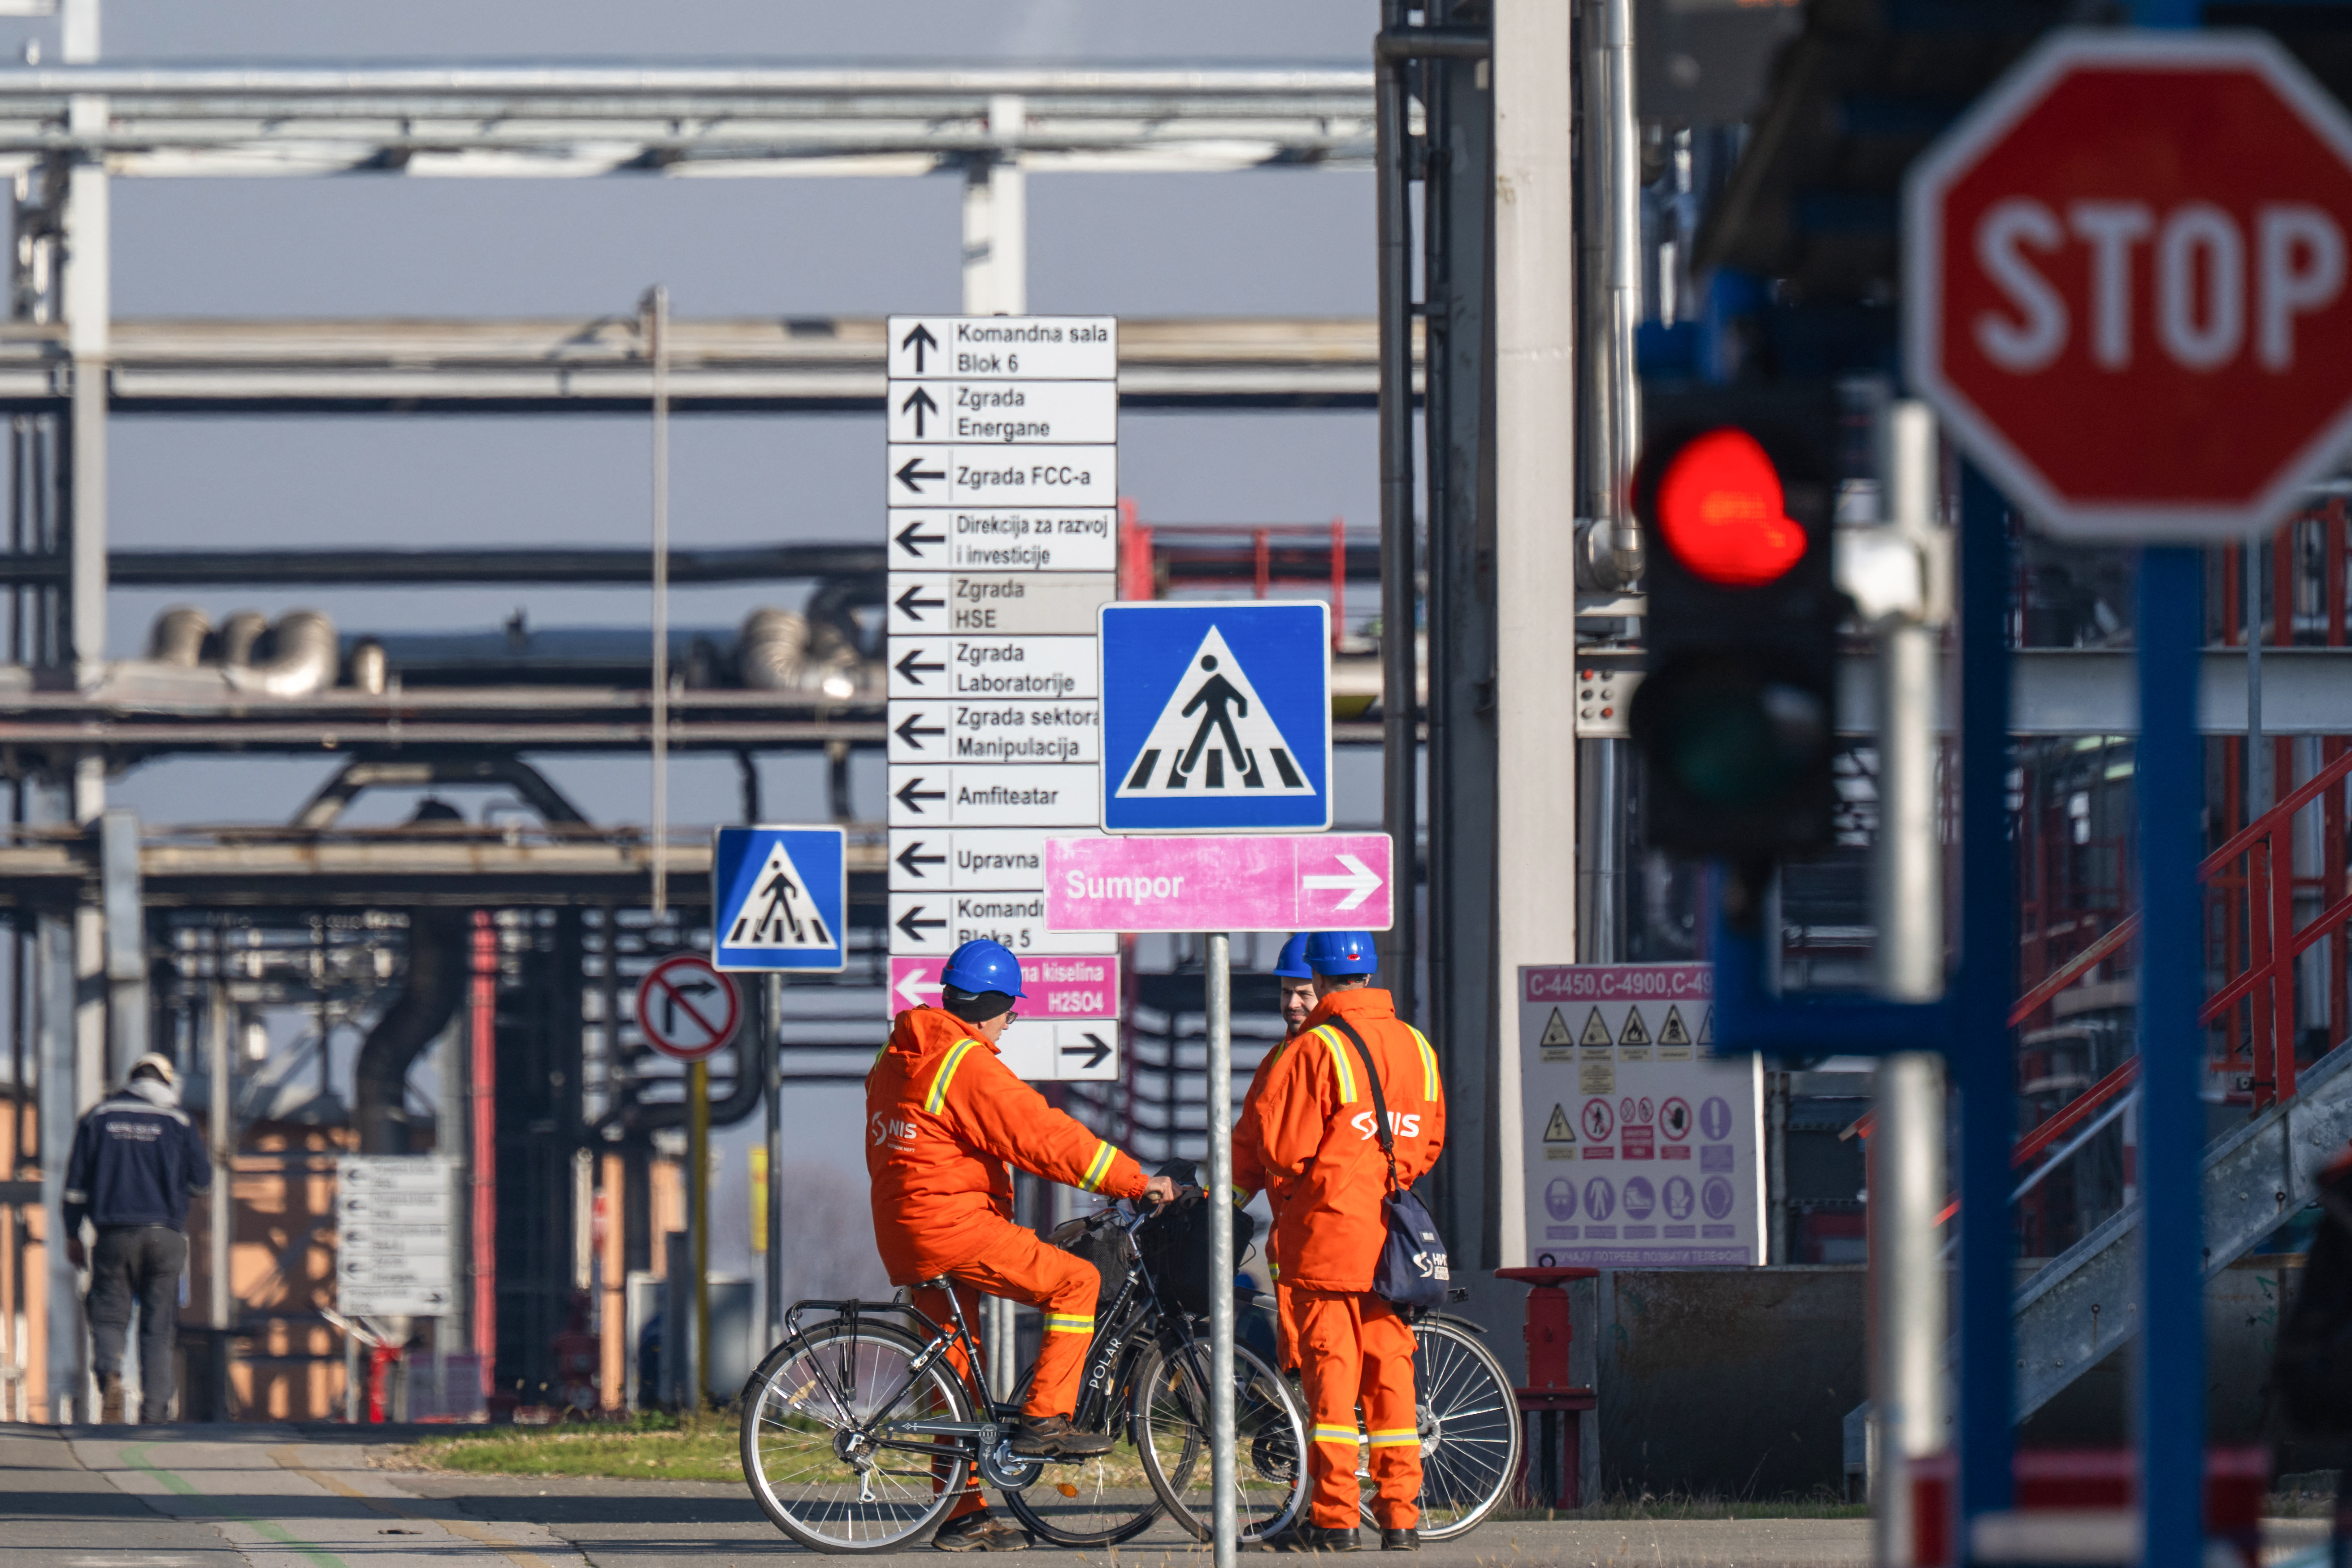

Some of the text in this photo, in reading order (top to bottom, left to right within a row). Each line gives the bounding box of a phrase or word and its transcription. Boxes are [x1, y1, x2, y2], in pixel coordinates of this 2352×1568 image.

[1976, 201, 2345, 371] STOP
[958, 324, 1108, 342] Komandna sala
[958, 354, 1019, 373] Blok 6
[957, 388, 1025, 411] Zgrada
[958, 418, 1050, 442] Energane
[957, 467, 1091, 490] Zgrada FCC-a
[957, 516, 1108, 539] Direkcija za razvoj
[957, 546, 1050, 570] i investicije
[957, 579, 1025, 602] Zgrada
[956, 610, 996, 628] HSE
[957, 644, 1024, 666] Zgrada
[957, 674, 1076, 698] Laboratorije
[956, 707, 1024, 730] Zgrada
[958, 738, 1079, 762] Manipulacija
[958, 786, 1059, 806] Amfiteatar
[958, 851, 1039, 873] Upravna
[1066, 870, 1185, 905] Sumpor
[958, 899, 1043, 917] Komand
[1020, 930, 1031, 948] 5
[1041, 962, 1104, 982] kiselina
[1530, 972, 1714, 997] C-4450,C-4900,C-49
[1048, 990, 1104, 1012] H2SO4
[889, 1119, 917, 1139] NIS
[1113, 1282, 1131, 1310] GRAZIA
[1089, 1338, 1122, 1389] POLAR
